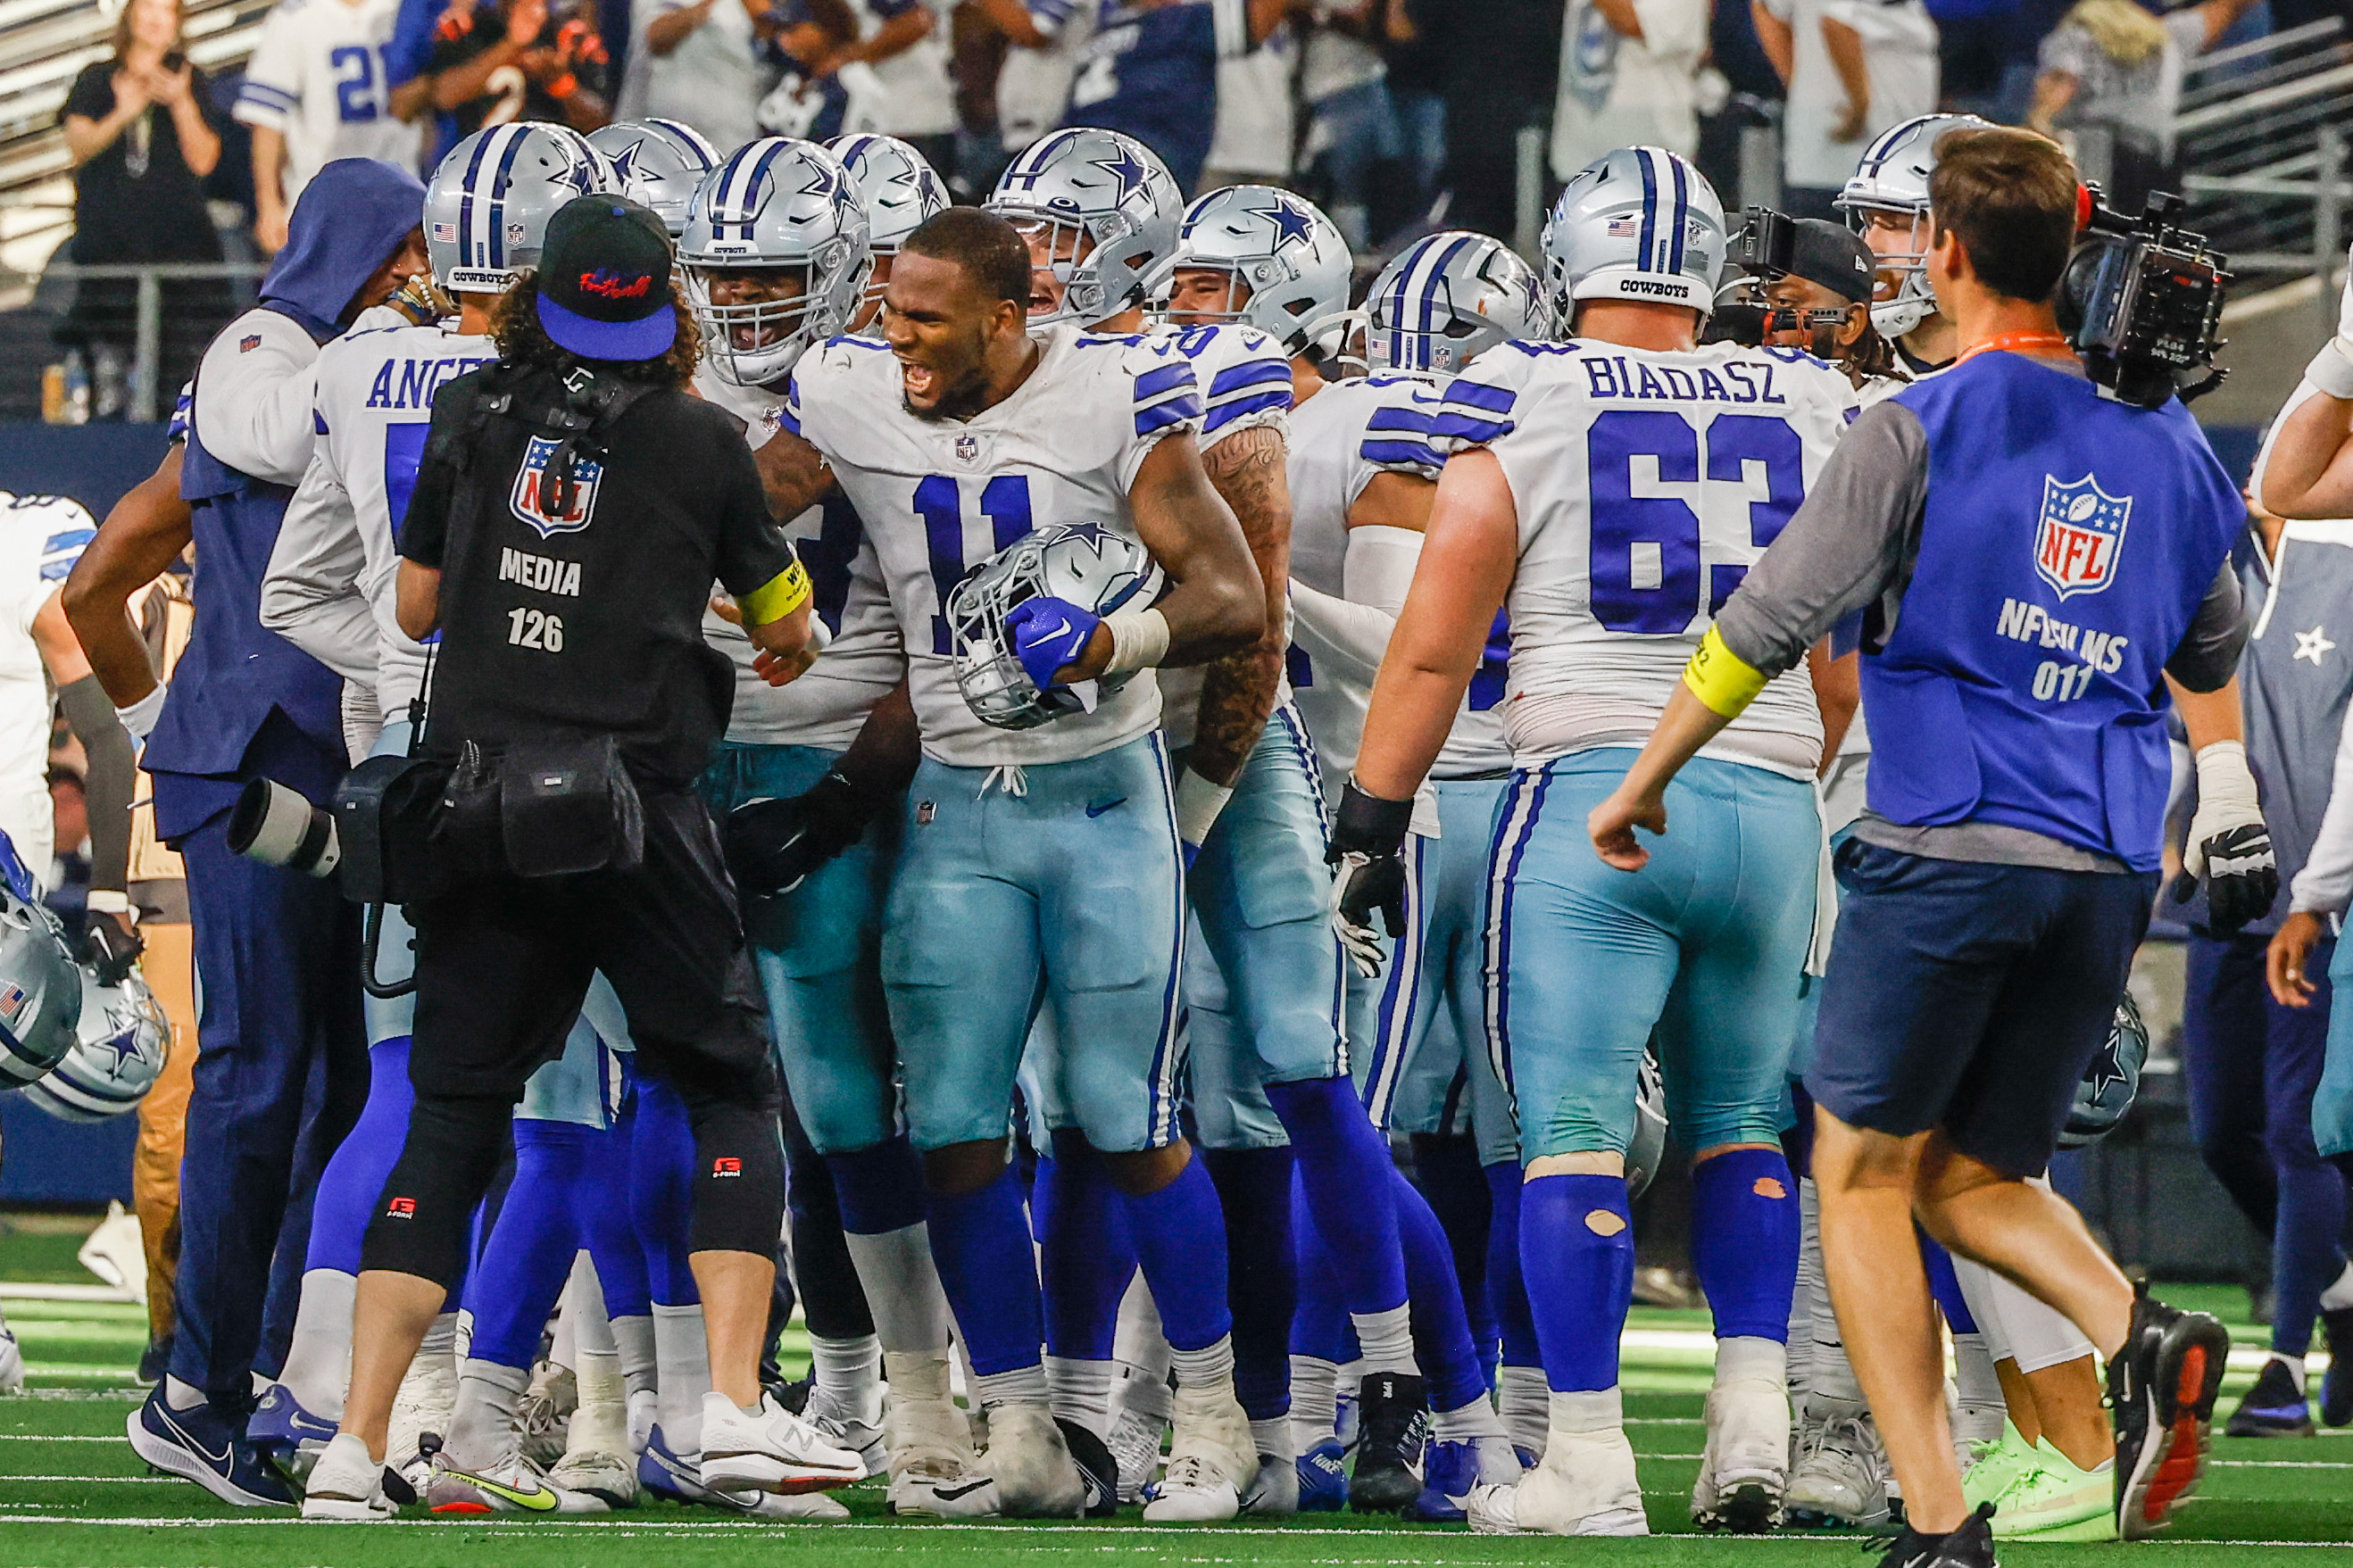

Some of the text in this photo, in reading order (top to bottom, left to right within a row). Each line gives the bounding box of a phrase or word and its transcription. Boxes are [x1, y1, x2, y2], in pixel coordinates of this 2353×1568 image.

[453, 272, 507, 284] COWBOY
[1620, 279, 1689, 298] COWBOYS
[1580, 356, 1786, 404] BIADASZ
[1587, 410, 1805, 635] 63
[498, 546, 582, 597] MEDIA
[912, 475, 1034, 657] 11
[2041, 522, 2105, 582] NFL
[507, 607, 564, 653] 126
[2032, 660, 2094, 711] 011
[712, 1169, 741, 1178] G-FORM
